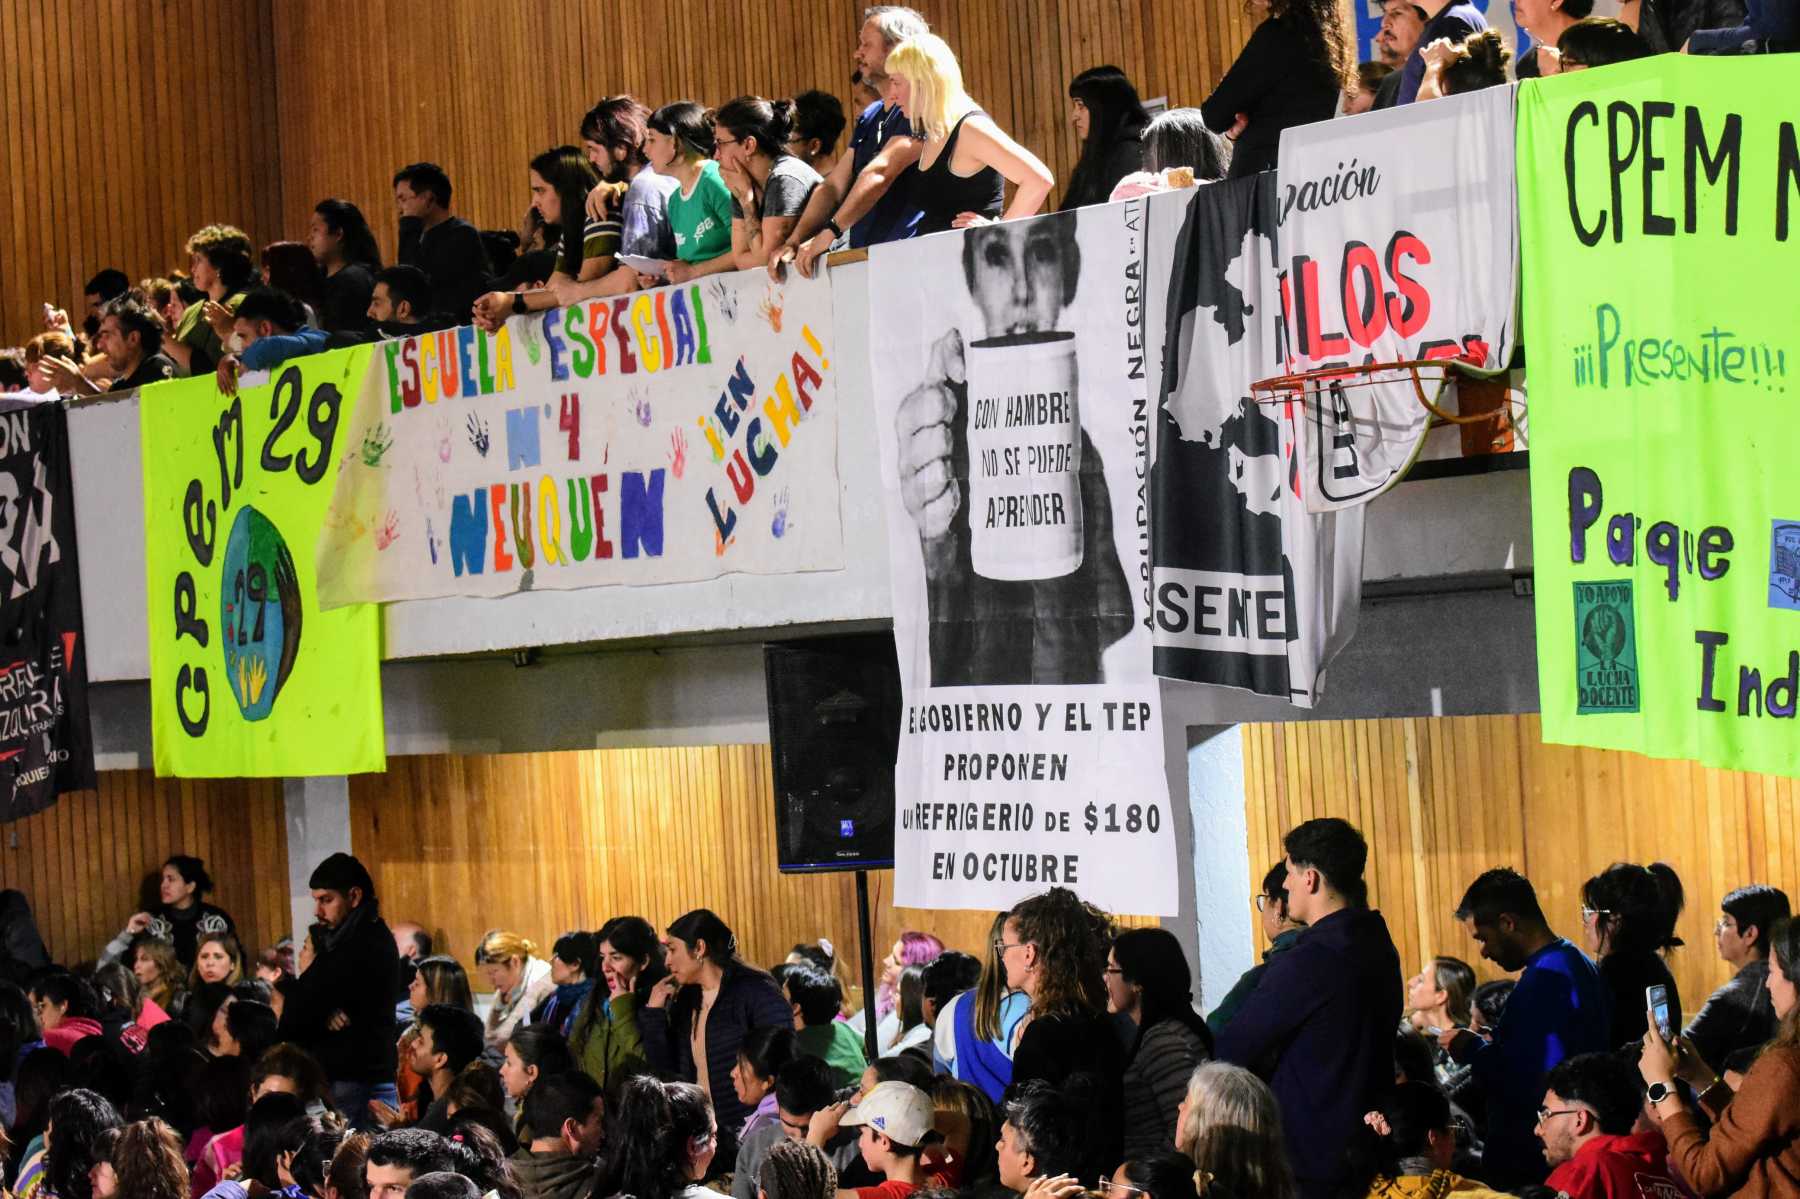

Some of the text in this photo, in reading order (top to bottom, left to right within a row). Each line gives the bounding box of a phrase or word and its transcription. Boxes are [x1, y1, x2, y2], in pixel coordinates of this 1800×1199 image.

[1564, 100, 1743, 248] CPEM
[1125, 260, 1146, 380] NEGRA
[385, 284, 712, 415] ESCUELA ESPECIAL
[260, 365, 343, 486] 29
[559, 392, 580, 461] 4
[974, 390, 1071, 431] CON HAMBRE
[705, 324, 830, 546] LUCHA!
[981, 442, 1072, 479] NO SE PUEDE
[449, 468, 665, 578] NEUQUEN
[985, 492, 1066, 529] APRENDER
[1596, 585, 1632, 604] APOYO
[1579, 686, 1635, 706] DOCENTE
[1586, 670, 1631, 686] LUCHA
[919, 702, 1023, 733] GOBIERNO
[1035, 703, 1053, 731] Y
[1064, 702, 1092, 732] EL
[1102, 702, 1151, 732] TEP
[943, 753, 1068, 781] PROPONEN
[915, 802, 1034, 831] REFRIGERIO
[1044, 811, 1071, 832] DE
[1084, 801, 1161, 835] $180
[932, 852, 1079, 884] EN OCTUBRE
